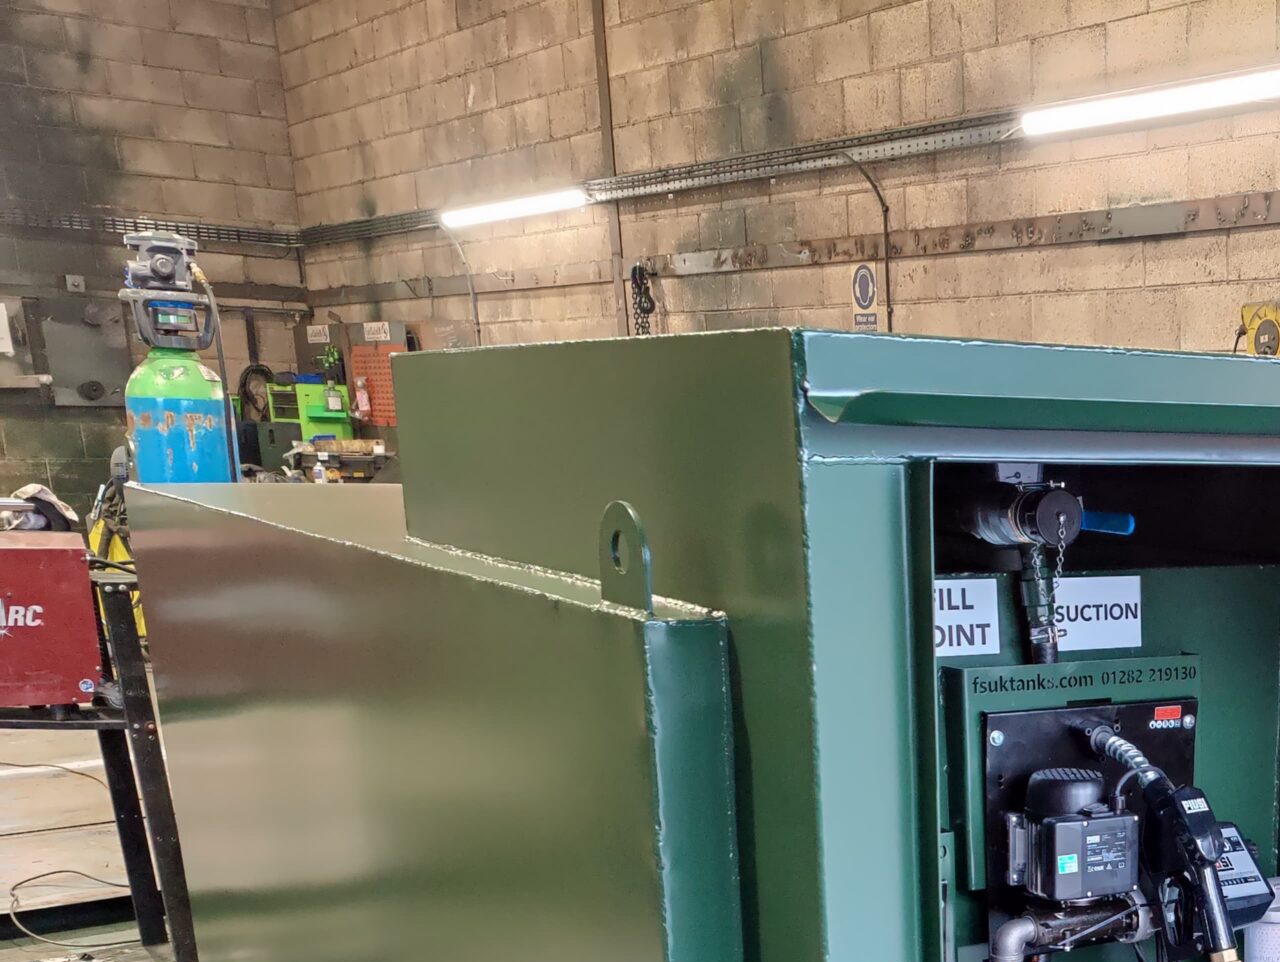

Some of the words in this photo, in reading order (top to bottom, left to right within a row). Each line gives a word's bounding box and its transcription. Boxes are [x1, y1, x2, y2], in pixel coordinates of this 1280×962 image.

[933, 587, 974, 611] ILL
[1054, 602, 1139, 623] SUCTION
[971, 673, 1094, 694] fsuktanks.com
[1101, 670, 1143, 686] 01282
[1148, 665, 1197, 682] 219130
[1181, 798, 1209, 813] PIUSI
